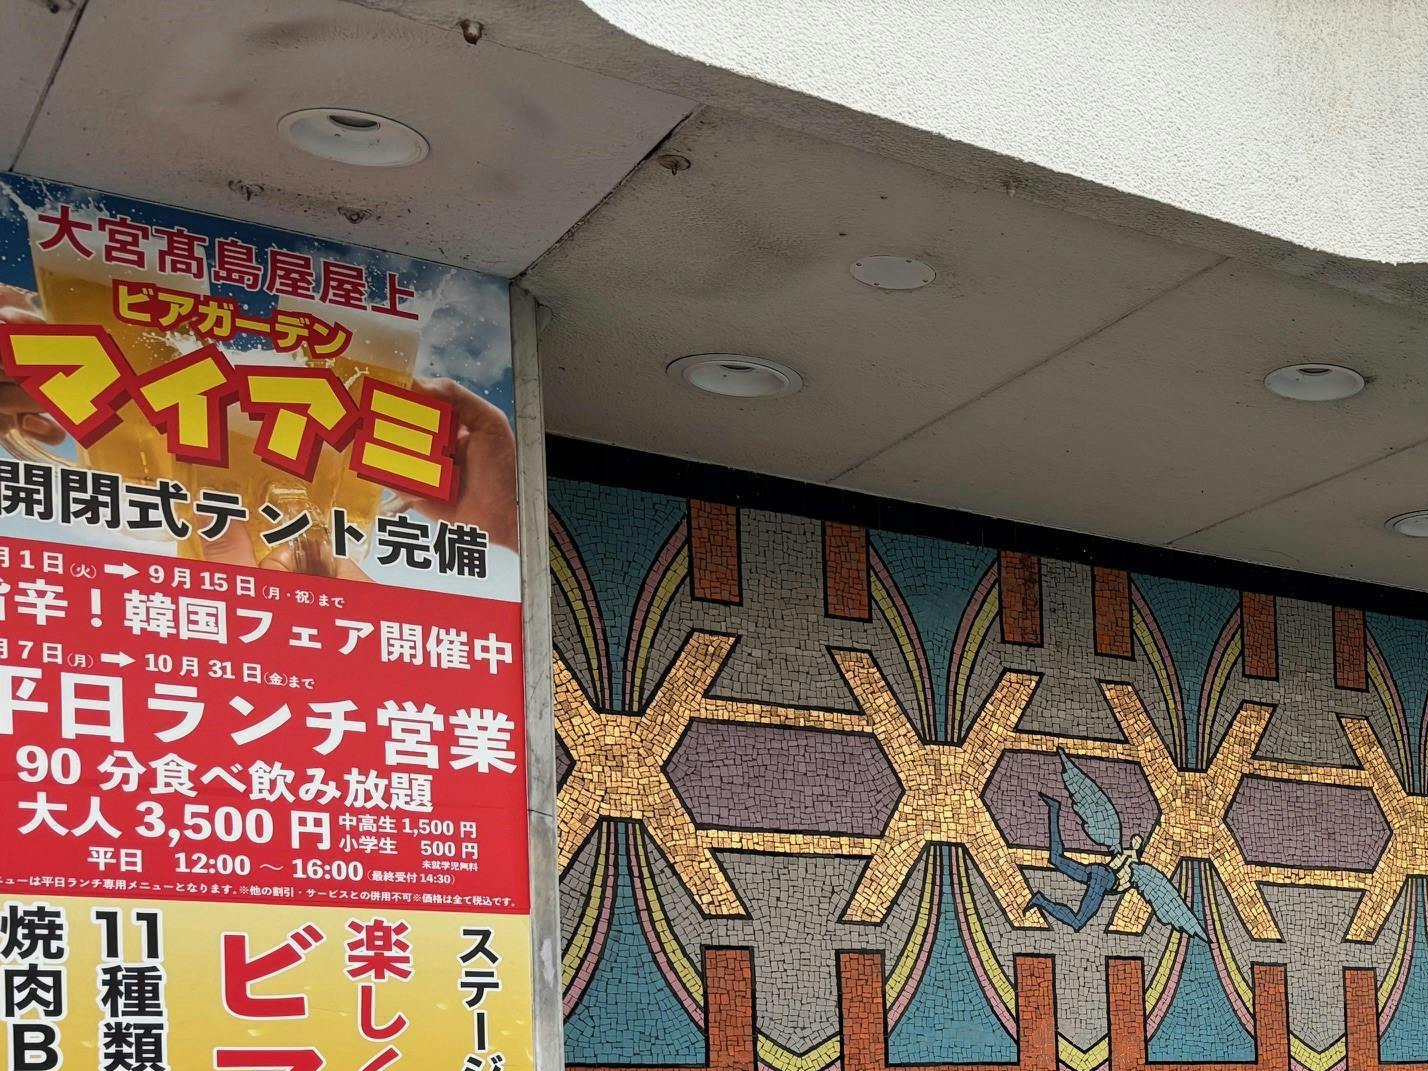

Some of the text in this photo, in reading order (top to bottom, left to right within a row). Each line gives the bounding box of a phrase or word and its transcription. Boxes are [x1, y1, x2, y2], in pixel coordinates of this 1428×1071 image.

[117, 284, 350, 359] ビアガーデン
[5, 330, 454, 494] マイアミ
[0, 461, 488, 579] 開閉式テント完備
[0, 577, 513, 675] 辛！韓国フェア開催中
[18, 791, 122, 839] 大人
[339, 813, 397, 833] 中高生
[87, 846, 143, 873] 平日
[174, 852, 251, 876] 12:00
[292, 858, 363, 881] 16:00
[339, 834, 398, 855] 小学生
[422, 860, 478, 872] 未就学児無料
